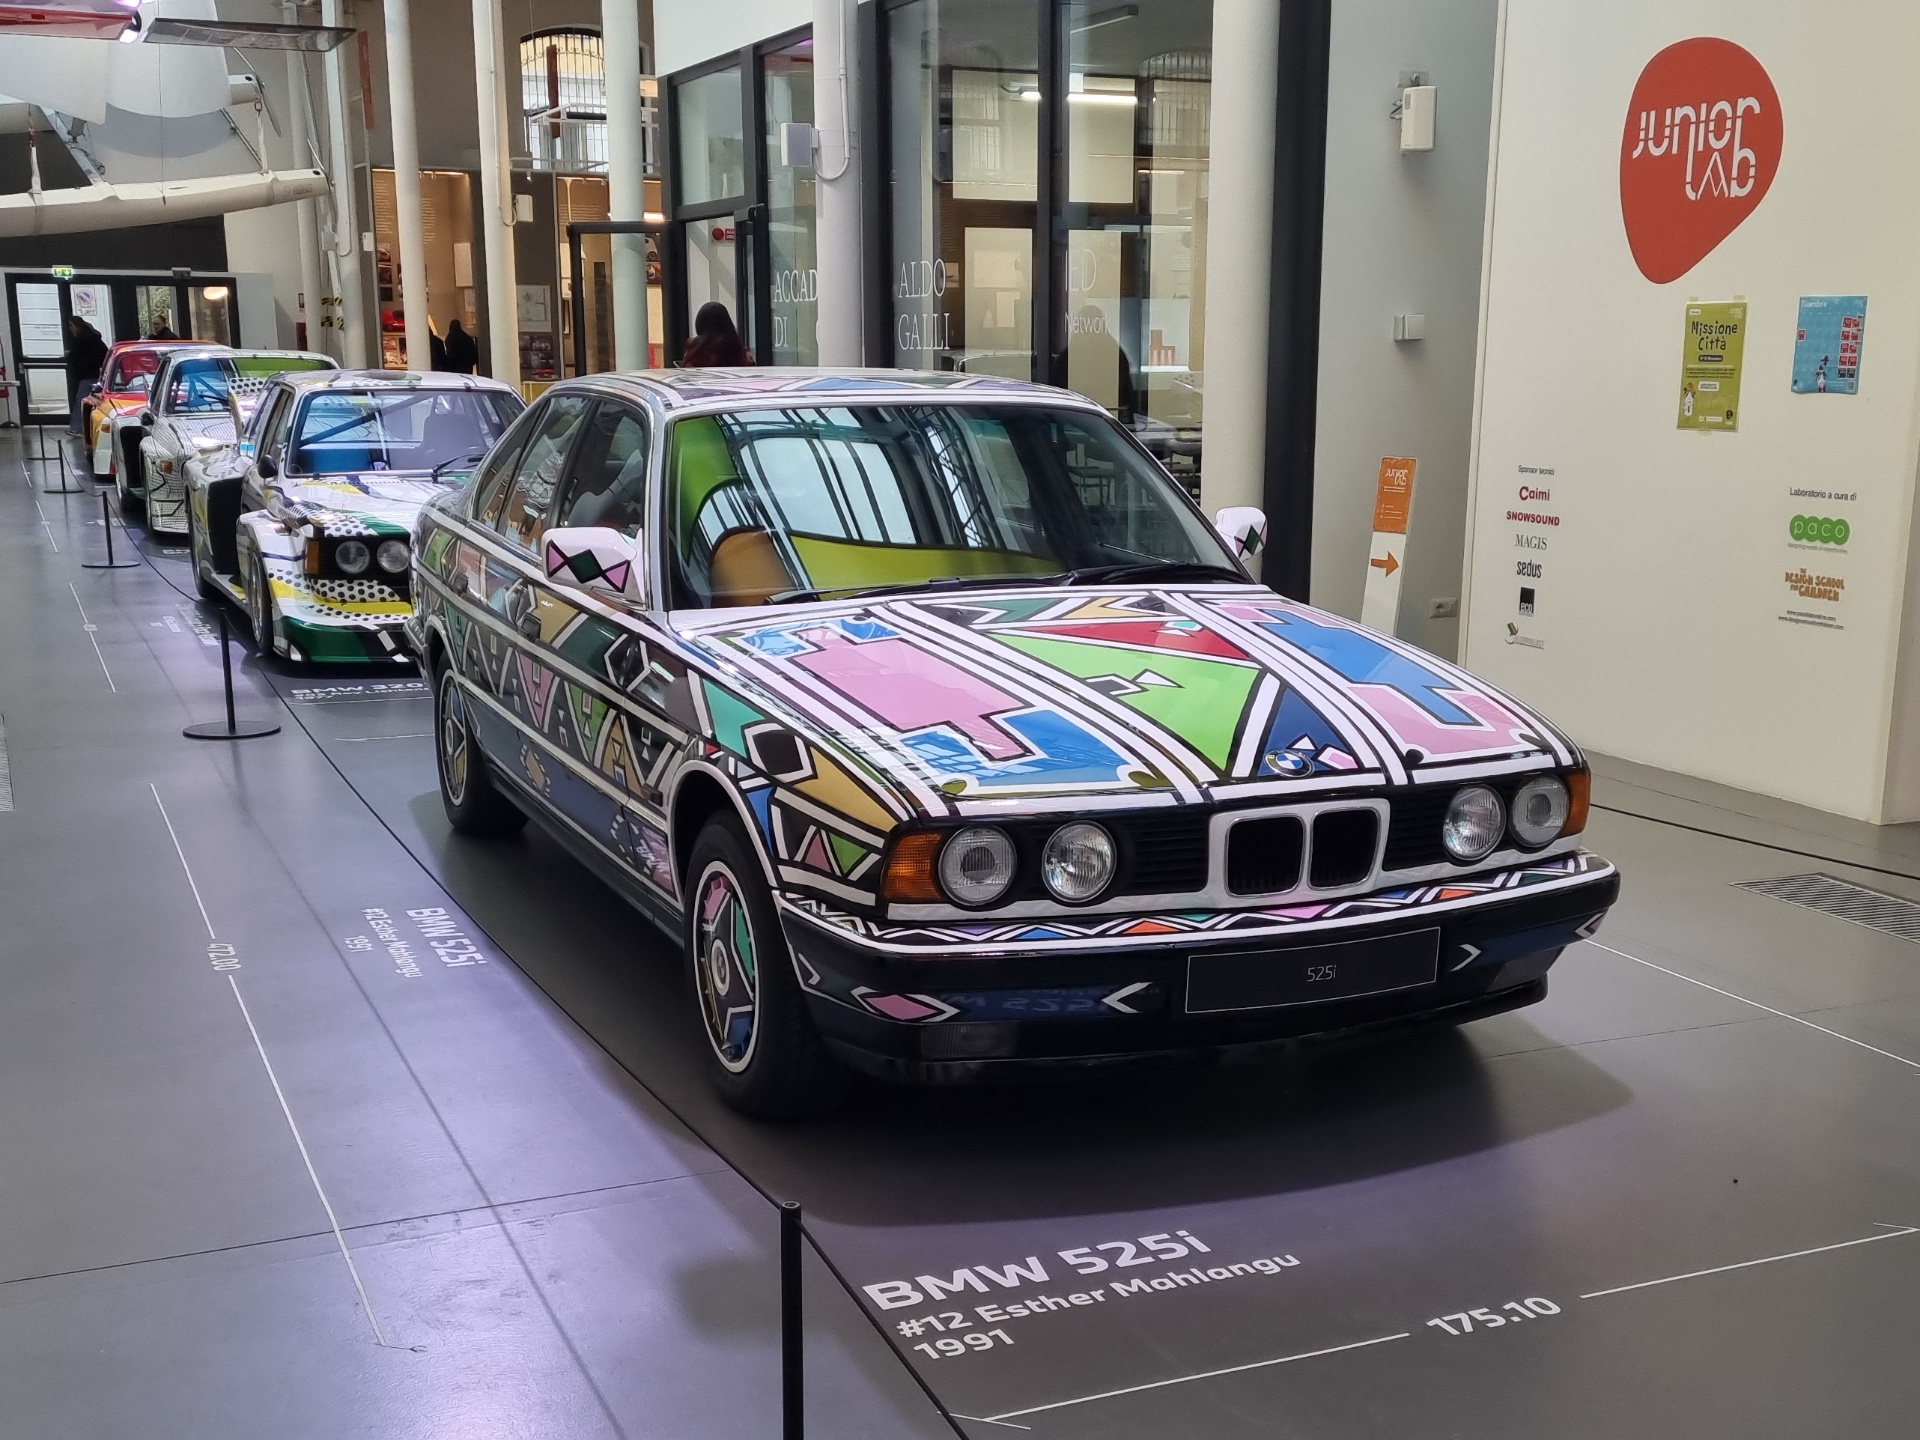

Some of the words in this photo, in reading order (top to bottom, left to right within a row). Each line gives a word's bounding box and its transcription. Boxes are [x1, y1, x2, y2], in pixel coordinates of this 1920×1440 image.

[898, 258, 946, 298] ALDO
[1065, 248, 1096, 292] IED
[774, 316, 789, 347] DI
[898, 312, 950, 350] GALLI
[1064, 311, 1111, 334] Network
[1691, 320, 1738, 336] Missione
[1698, 336, 1727, 351] Città
[1519, 485, 1550, 501] Caimi
[1789, 487, 1826, 499] Laboratorio
[1834, 493, 1849, 501] cura
[1850, 491, 1857, 501] di
[1506, 510, 1560, 526] SNOWSOUND
[1794, 521, 1845, 538] paco
[1515, 533, 1547, 551] MAGIS
[1516, 559, 1542, 579] sedus
[369, 919, 399, 942] Esther
[405, 907, 465, 938] BMW
[344, 935, 374, 953] 1991
[429, 938, 488, 968] 525i
[383, 940, 424, 979] Mahlangu
[1307, 964, 1337, 983] 525i
[862, 1256, 1051, 1311] BMW
[1057, 1230, 1212, 1275] 525i
[896, 1311, 974, 1338] #12
[974, 1287, 1107, 1323] Esther
[1108, 1254, 1302, 1297] Mahlangu
[1425, 1297, 1562, 1336] 175.10
[913, 1328, 1015, 1360] 1991
